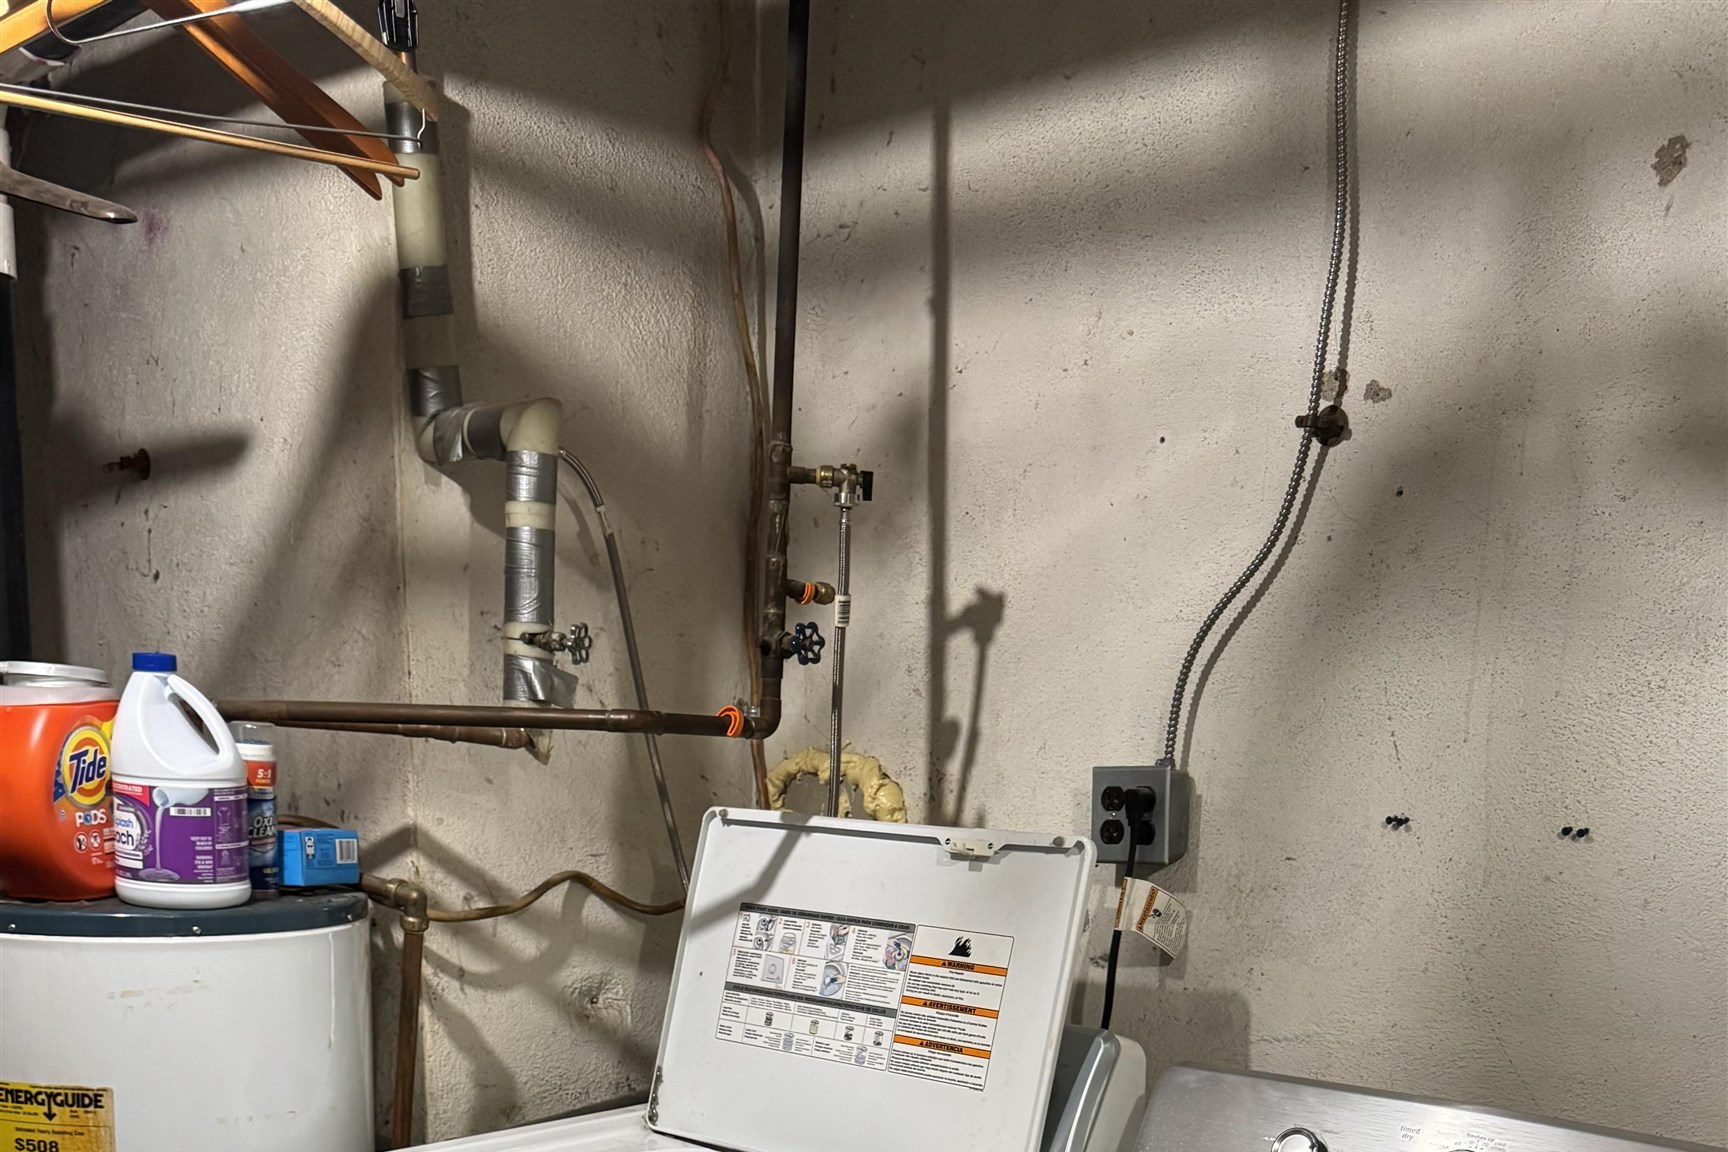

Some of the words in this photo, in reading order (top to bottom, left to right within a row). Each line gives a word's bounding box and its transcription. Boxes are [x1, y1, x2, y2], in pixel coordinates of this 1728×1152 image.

[69, 747, 107, 795] Tide
[75, 809, 107, 827] PODS
[947, 960, 975, 970] WARNING
[928, 1001, 976, 1014] AVERTISSEMENT
[925, 1041, 963, 1053] ADVERTENCIA
[1400, 1125, 1421, 1135] timed
[1401, 1133, 1414, 1141] dry
